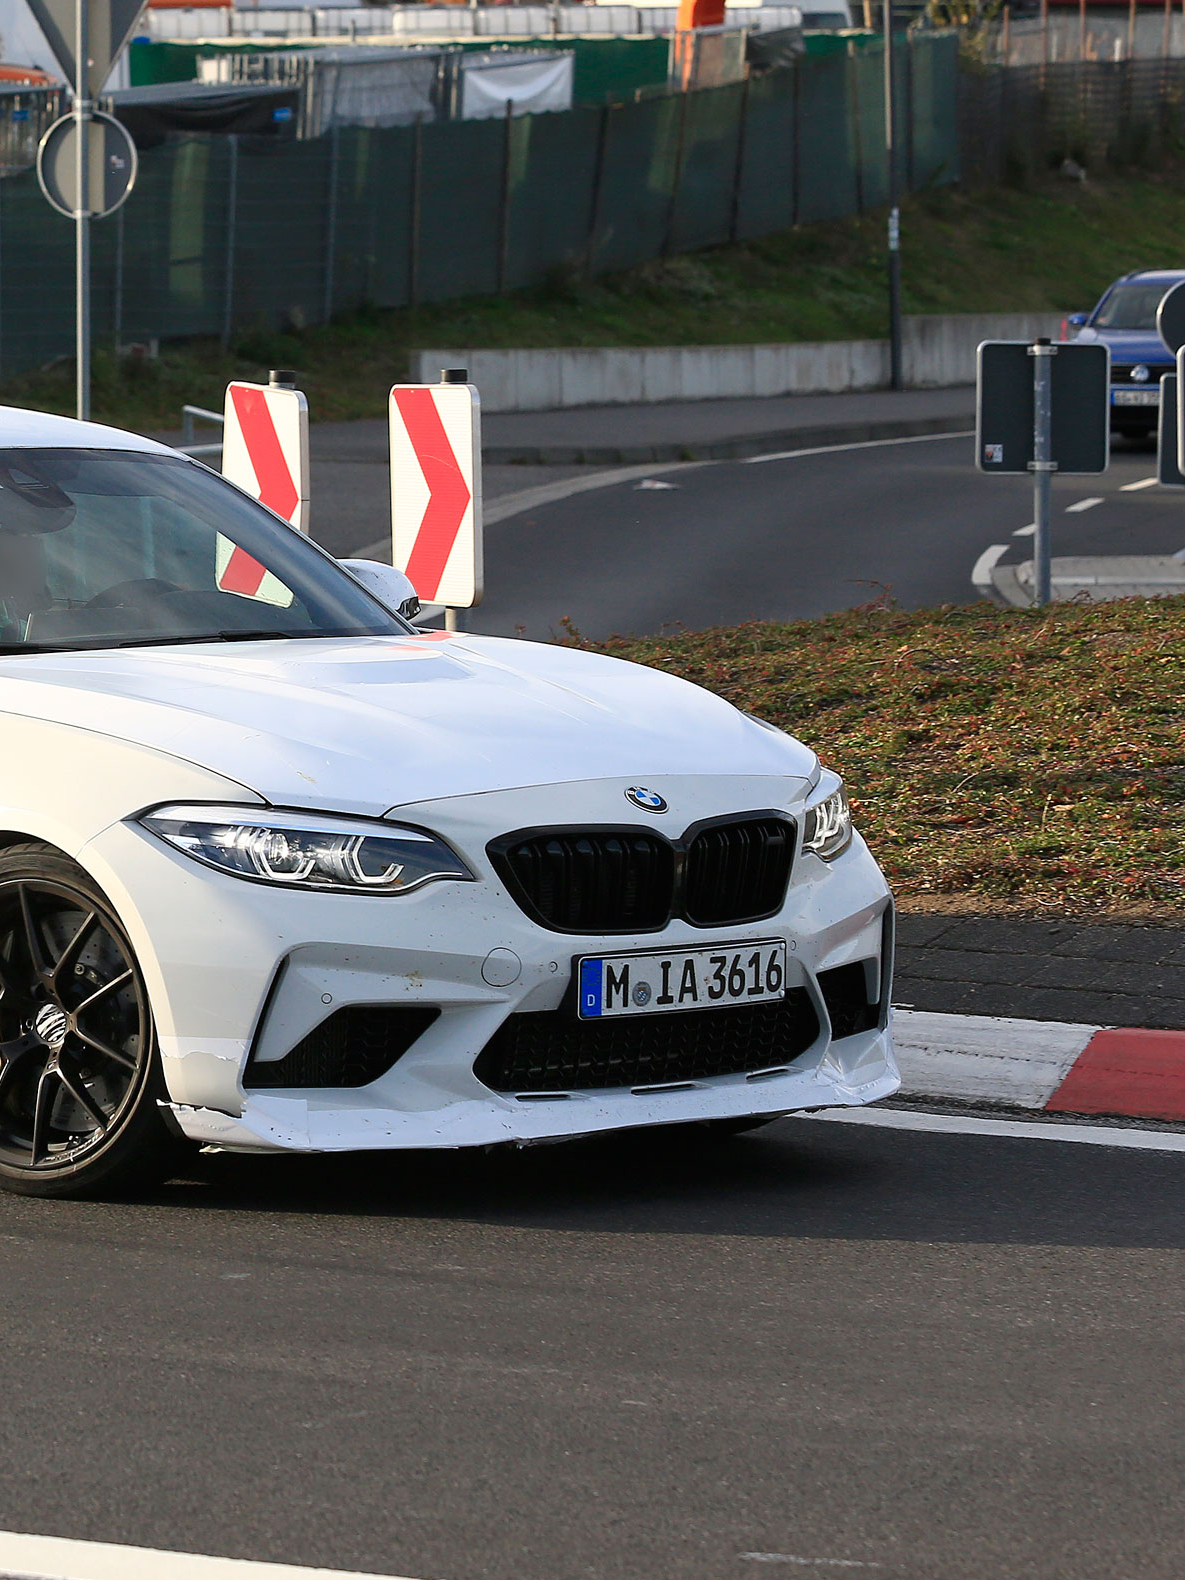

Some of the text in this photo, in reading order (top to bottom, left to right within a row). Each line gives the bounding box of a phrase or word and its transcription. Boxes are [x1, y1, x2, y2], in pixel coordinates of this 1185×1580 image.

[606, 949, 783, 1009] M IA 3616
[586, 994, 596, 1007] D
